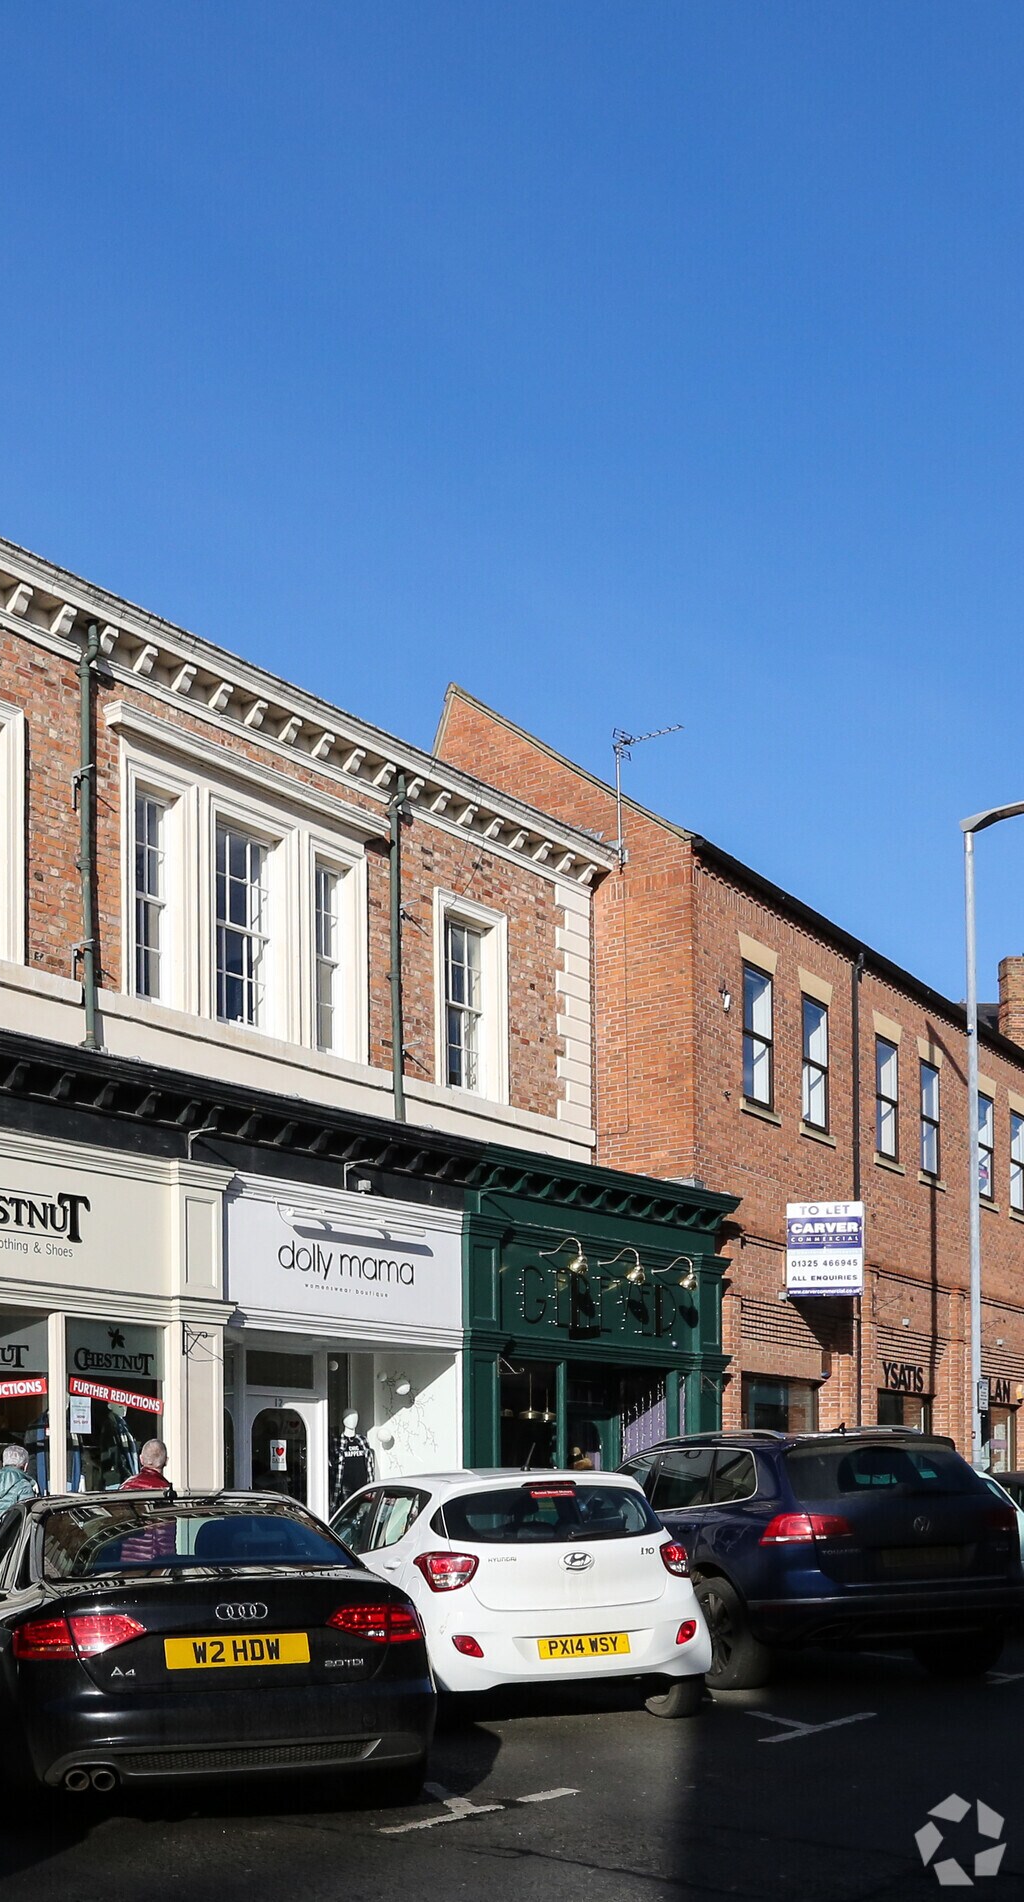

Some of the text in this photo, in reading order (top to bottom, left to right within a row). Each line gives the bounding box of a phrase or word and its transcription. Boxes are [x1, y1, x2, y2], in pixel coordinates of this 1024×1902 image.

[799, 1204, 850, 1216] TO LET
[790, 1221, 859, 1234] CARVER
[33, 1241, 42, 1254] &
[45, 1242, 74, 1258] Shoes
[278, 1240, 415, 1286] dolly mama
[791, 1259, 858, 1268] 01325 466945
[304, 1283, 389, 1298] womenswear boutique
[882, 1361, 924, 1393] YSATIS
[72, 1379, 109, 1400] FURTHER
[110, 1388, 161, 1412] REDUCTIONS
[988, 1377, 1011, 1404] LAN
[192, 1638, 280, 1664] W2 HDW
[548, 1637, 618, 1656] PX14 WSY
[110, 1666, 137, 1677] A4
